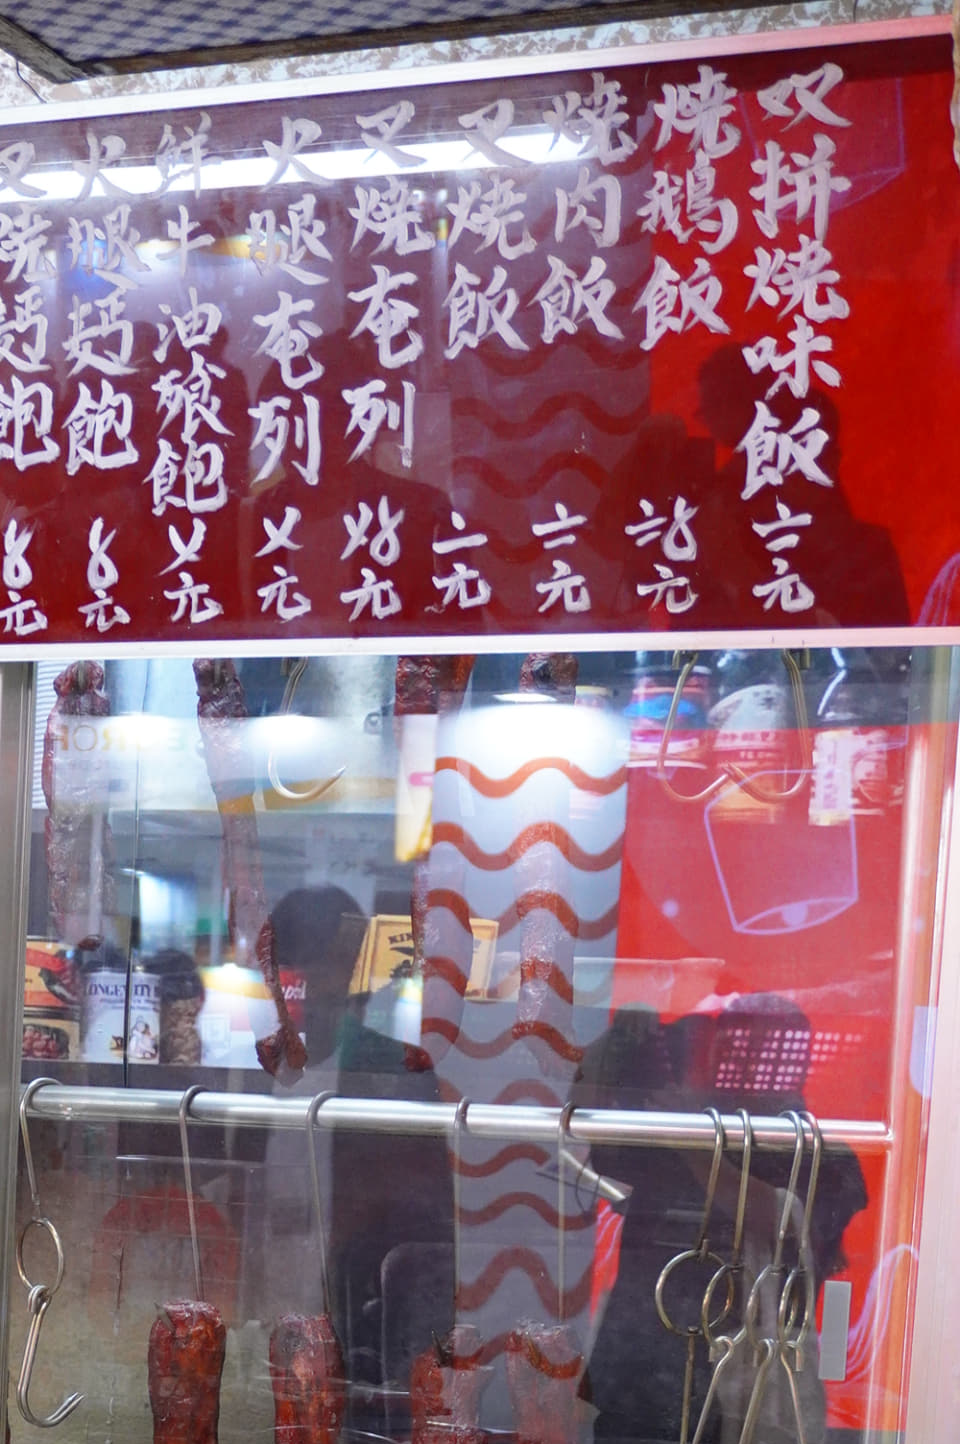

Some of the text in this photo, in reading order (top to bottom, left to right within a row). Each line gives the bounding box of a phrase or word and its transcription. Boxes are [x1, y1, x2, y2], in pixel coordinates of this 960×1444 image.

[442, 98, 539, 361] 叉燒飯
[527, 71, 639, 345] 燒肉飯
[632, 64, 742, 352] 燒鵝飯
